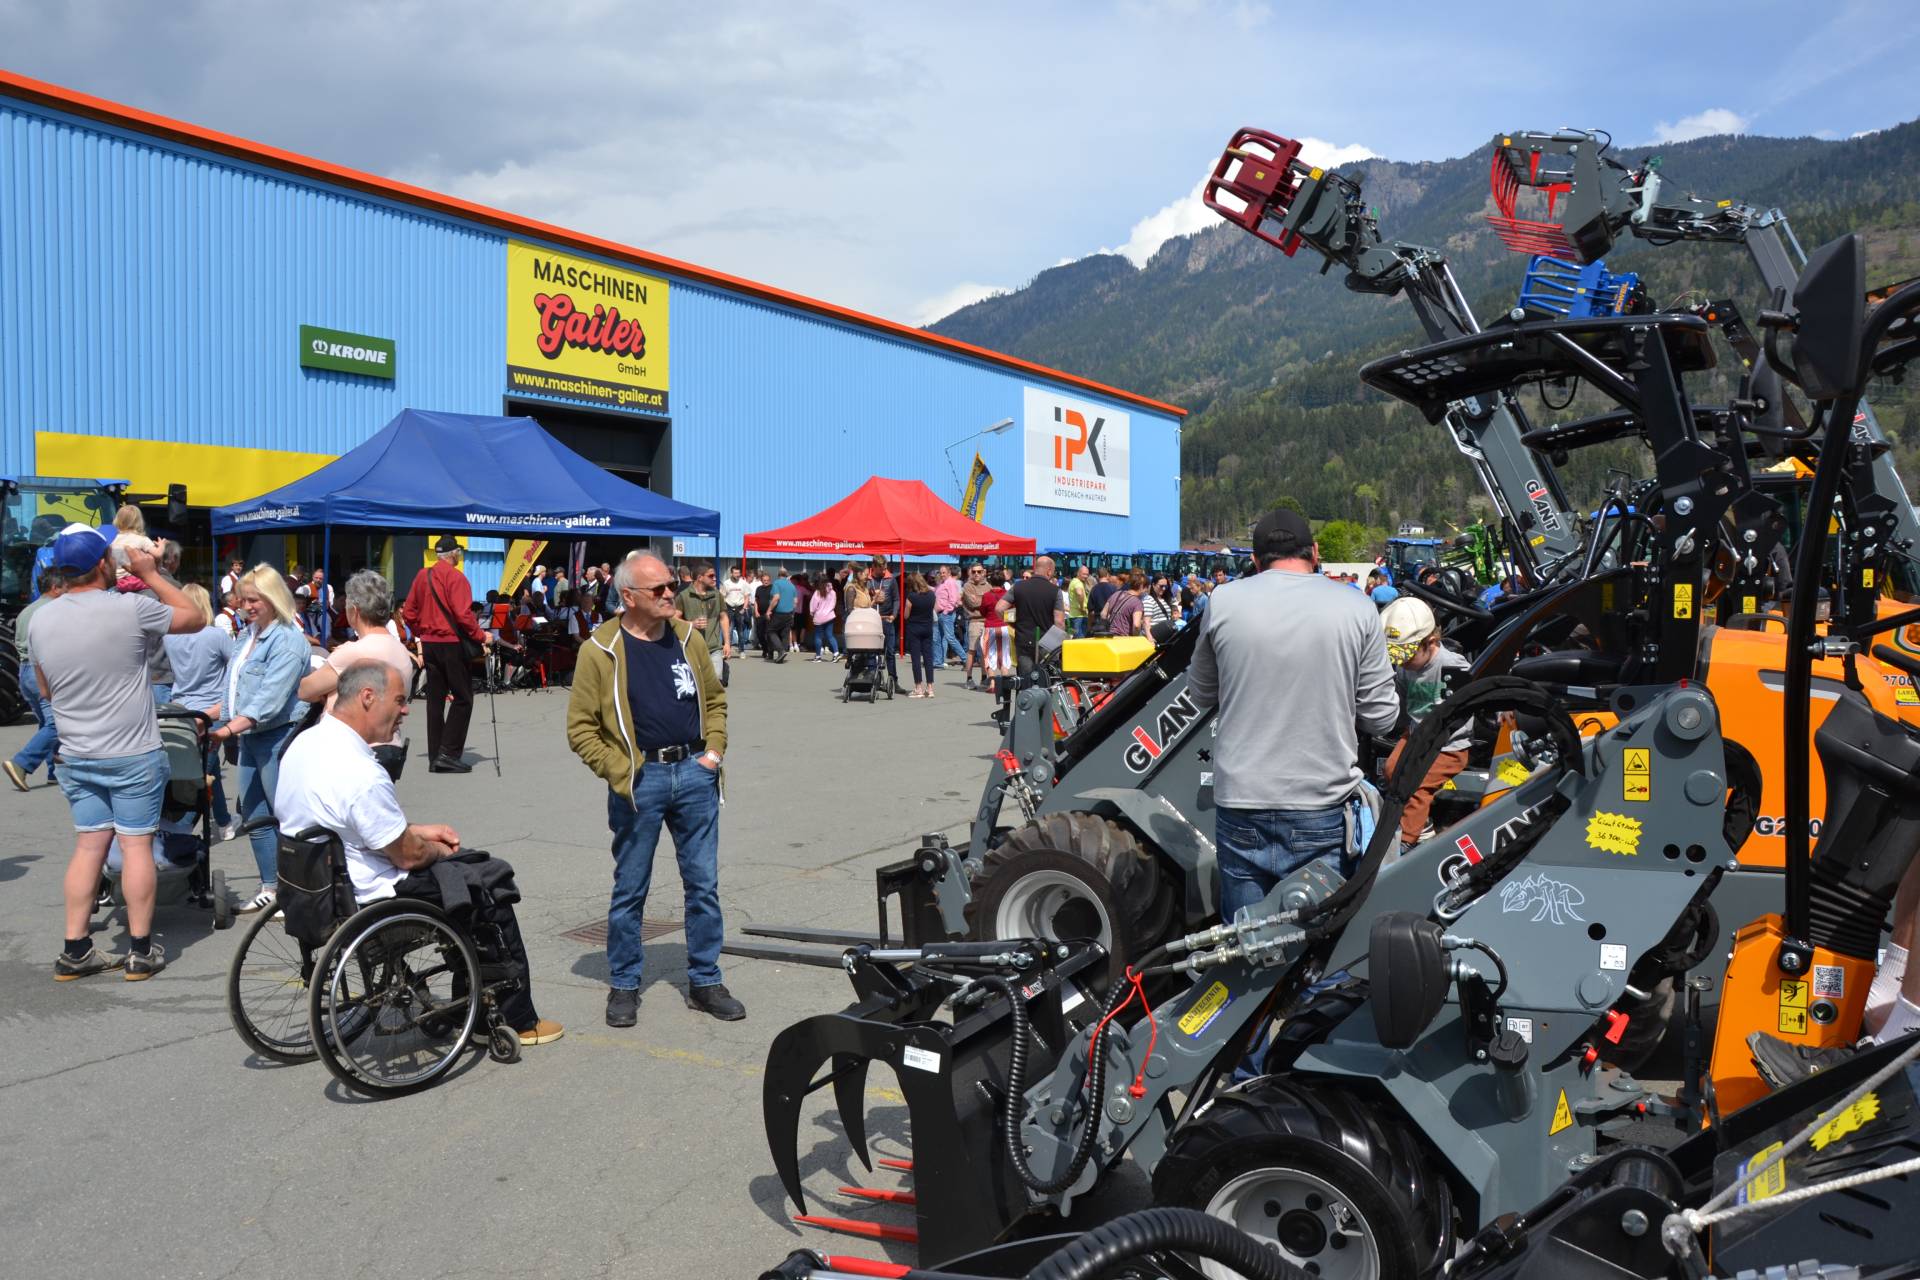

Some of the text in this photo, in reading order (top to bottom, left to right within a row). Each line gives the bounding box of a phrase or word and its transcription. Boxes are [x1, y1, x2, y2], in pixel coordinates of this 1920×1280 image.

[533, 258, 647, 304] MASCHINEN
[534, 292, 646, 360] Gailer
[329, 343, 387, 364] KRONE
[617, 362, 647, 377] GmbH
[513, 372, 663, 406] www.maschinen-gailer.at
[1054, 475, 1106, 491] INDUSTRIEPARK
[1525, 480, 1561, 531] GIANT
[466, 513, 611, 528] www.maschinen-gailer.at
[675, 543, 683, 553] 16
[776, 539, 865, 549] www.maschinen-gailer.at
[1124, 686, 1200, 774] GIAN
[1180, 984, 1222, 1029] LANDTECHNIK
